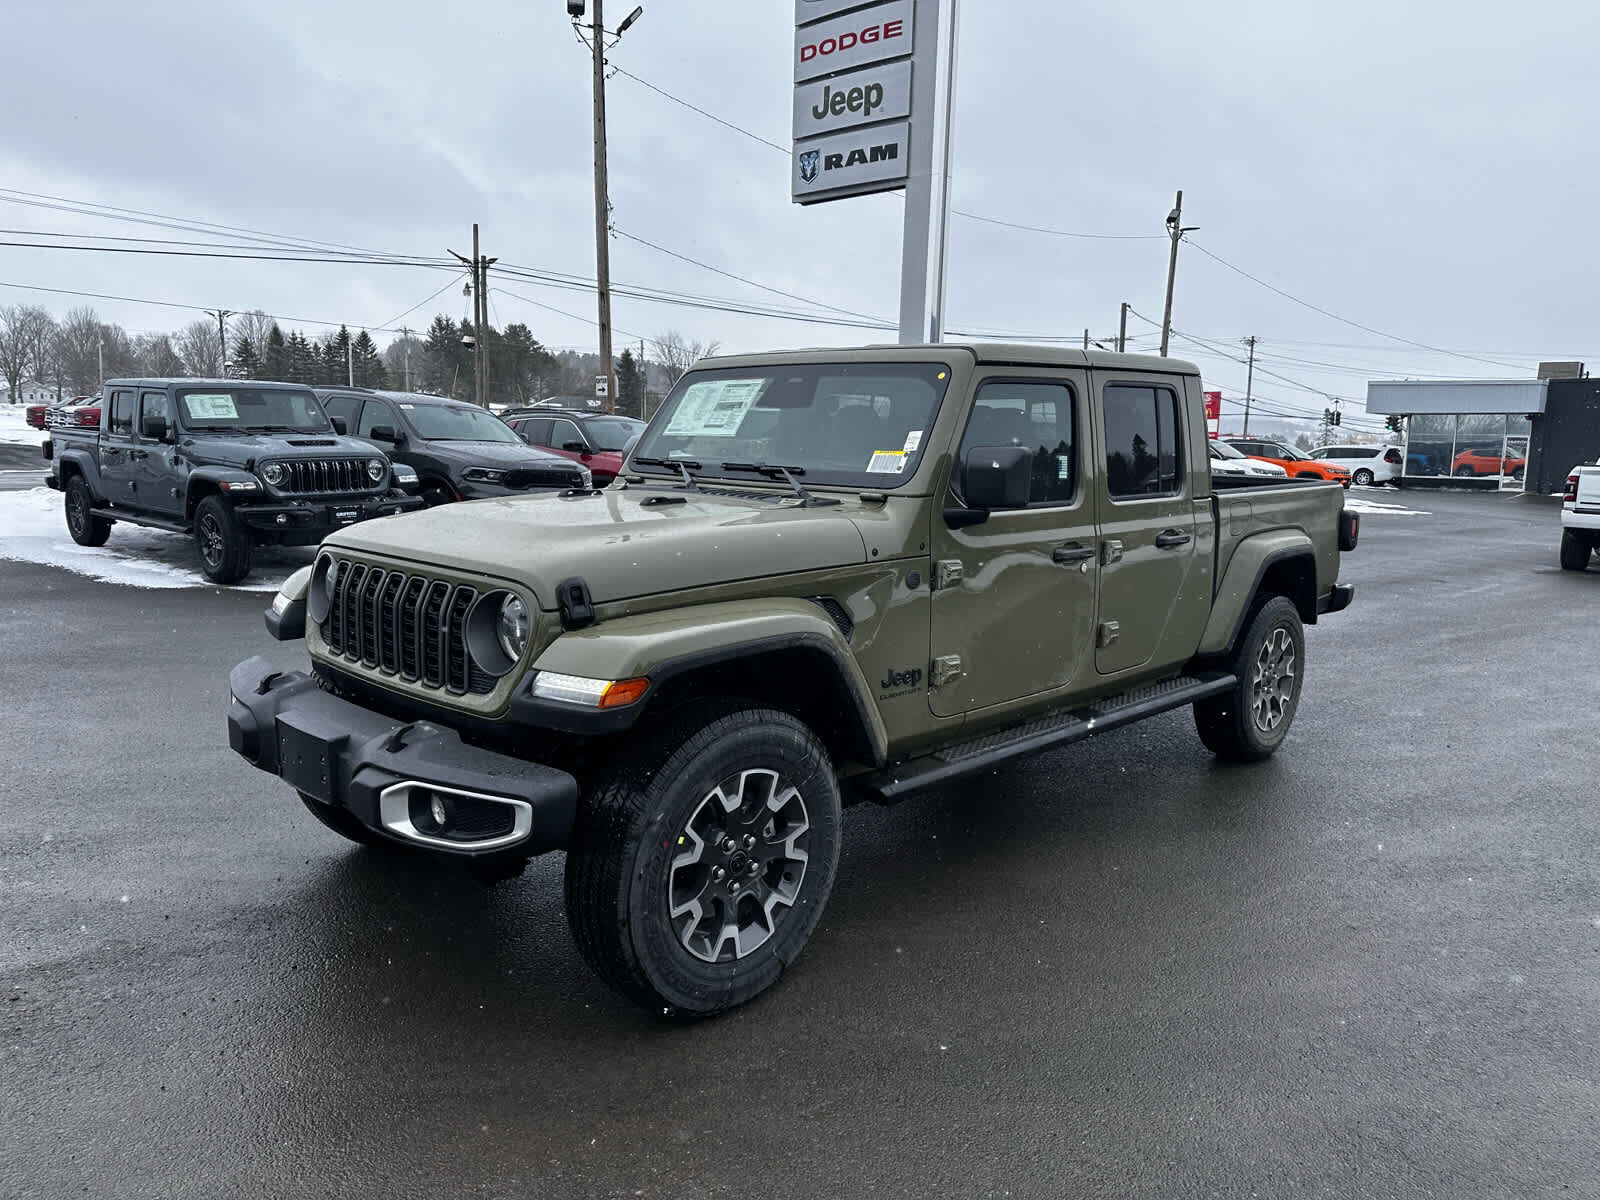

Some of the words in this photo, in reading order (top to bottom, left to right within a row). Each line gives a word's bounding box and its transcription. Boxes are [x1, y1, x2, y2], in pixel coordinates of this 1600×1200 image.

[800, 20, 903, 63] DODGE
[812, 83, 883, 119] Jeep
[824, 142, 899, 171] RAM
[881, 668, 922, 688] Jeep
